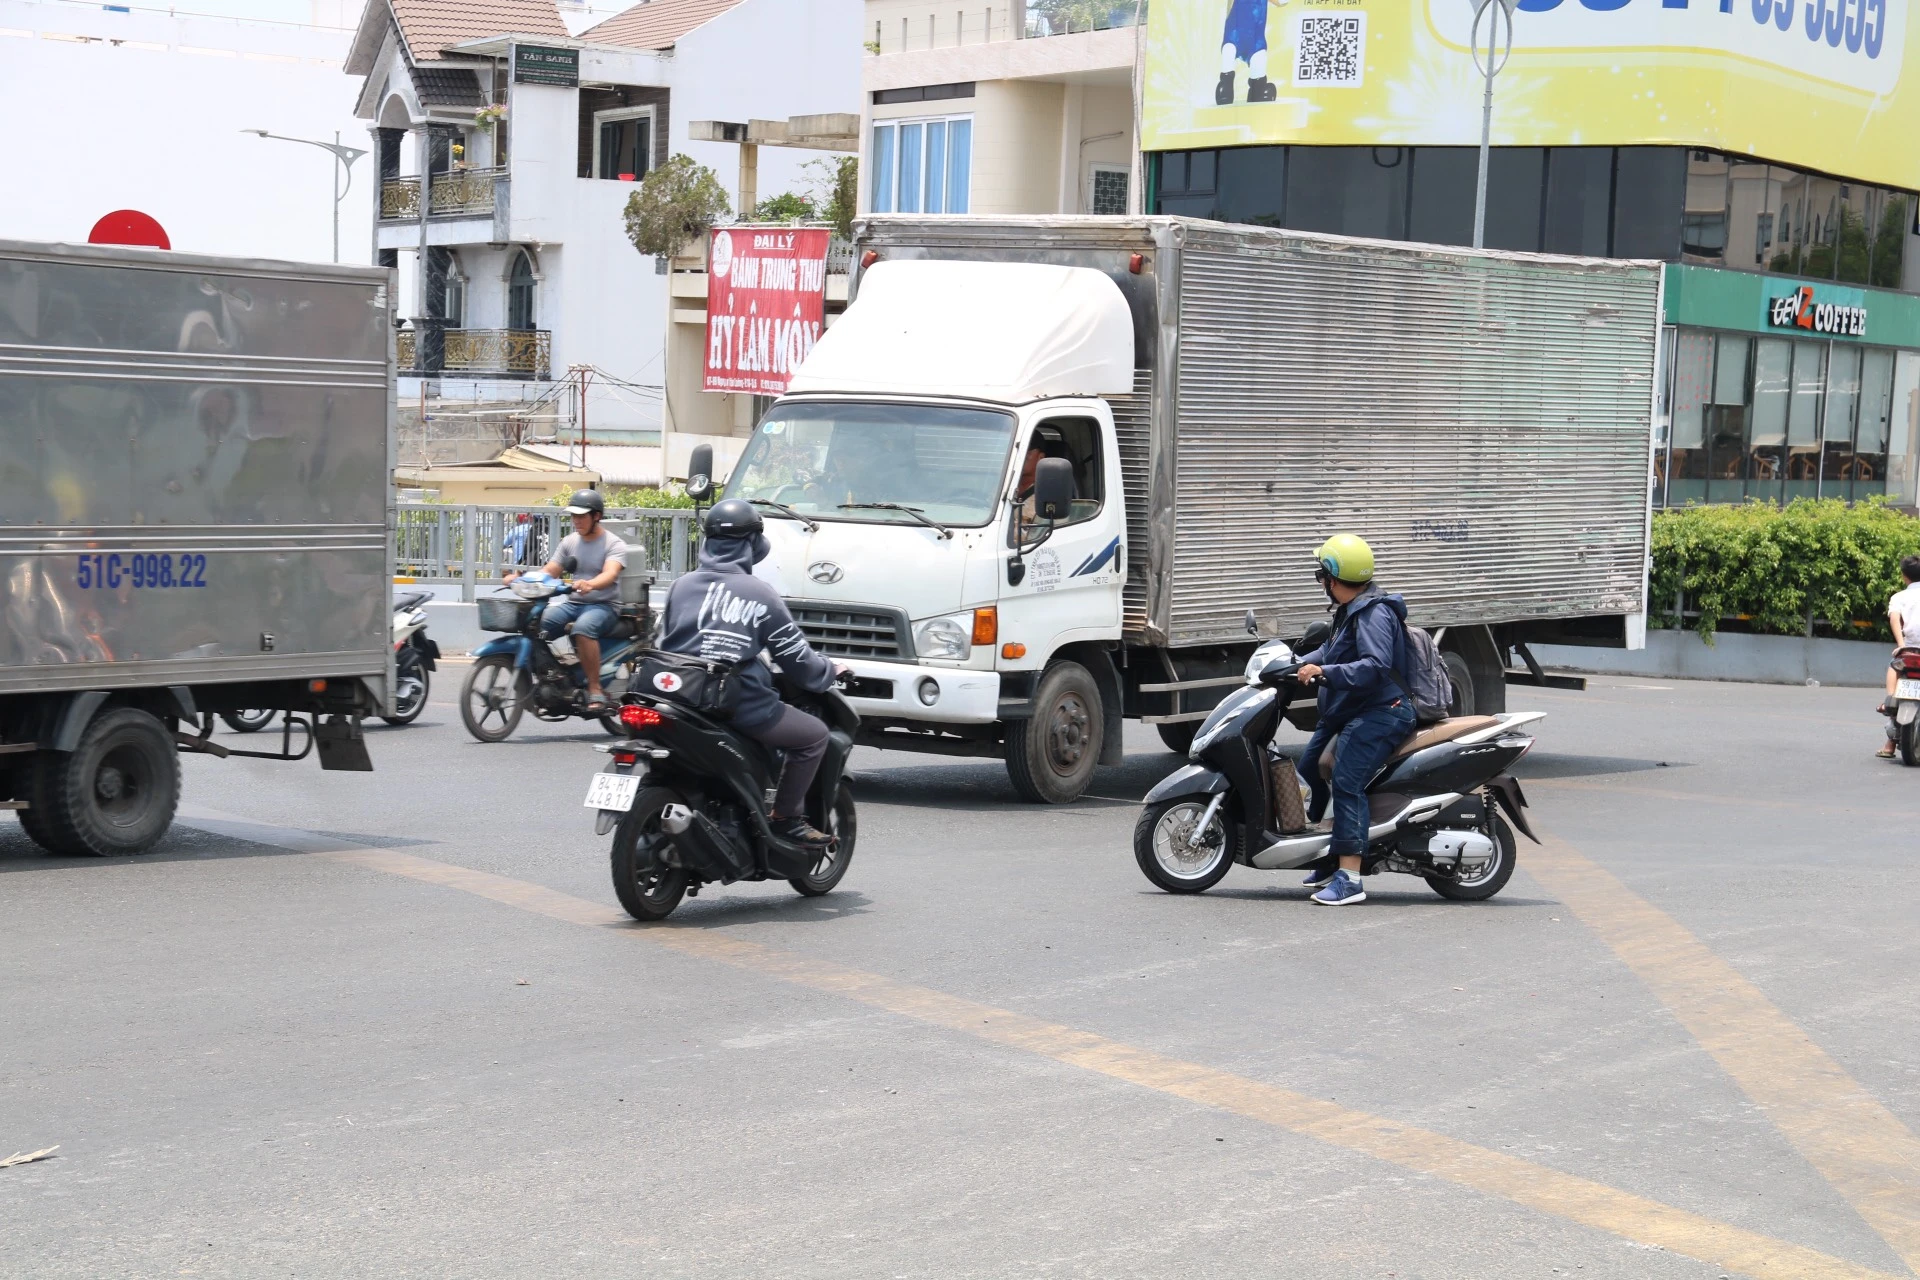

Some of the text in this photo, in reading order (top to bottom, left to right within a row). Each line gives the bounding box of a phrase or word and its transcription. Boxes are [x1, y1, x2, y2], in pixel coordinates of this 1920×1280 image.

[753, 231, 796, 249] ĐẠI LÝ
[730, 250, 824, 293] BÁNH TRUNG THU
[737, 299, 771, 373] LÂM
[1815, 303, 1867, 336] COFFEE
[77, 553, 207, 589] 51C-998.22
[588, 791, 631, 809] 448.12
[597, 776, 631, 792] 84-H1
